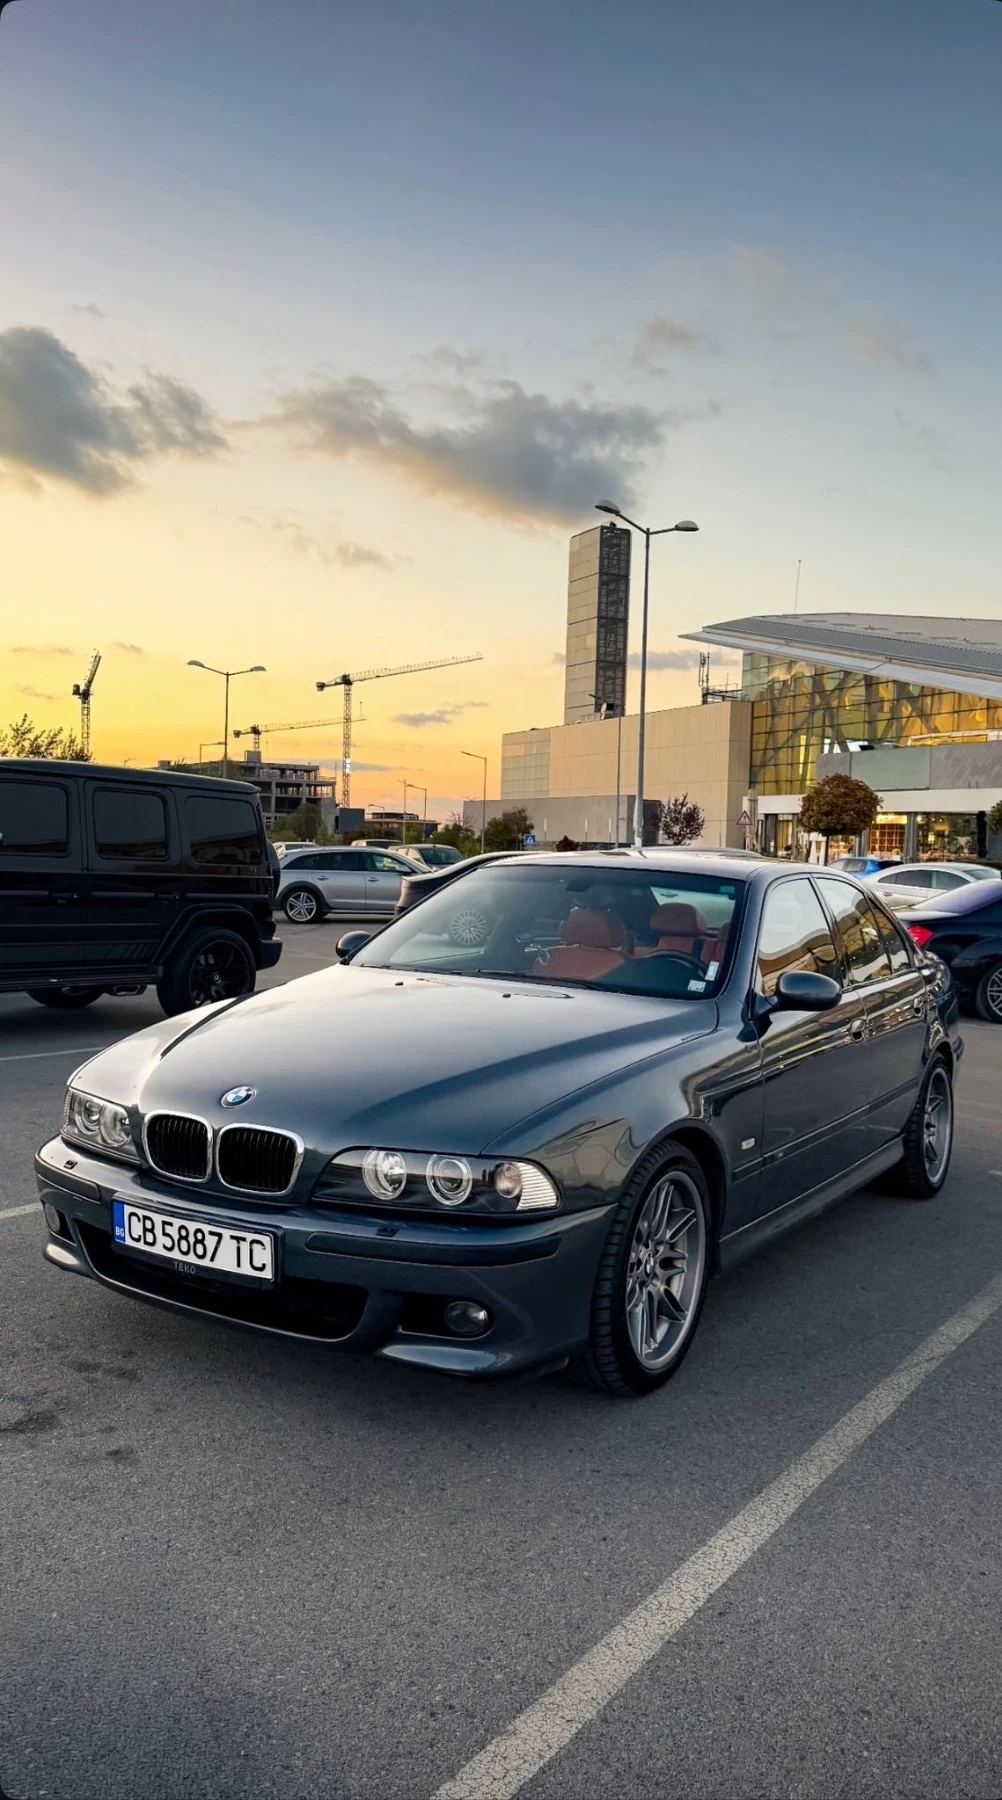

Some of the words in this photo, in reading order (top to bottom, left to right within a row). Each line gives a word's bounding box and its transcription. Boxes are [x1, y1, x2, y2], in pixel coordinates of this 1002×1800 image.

[115, 1226, 125, 1237] BG
[161, 1219, 223, 1262] 5887
[229, 1235, 267, 1272] TC
[173, 1261, 197, 1275] TEKO
